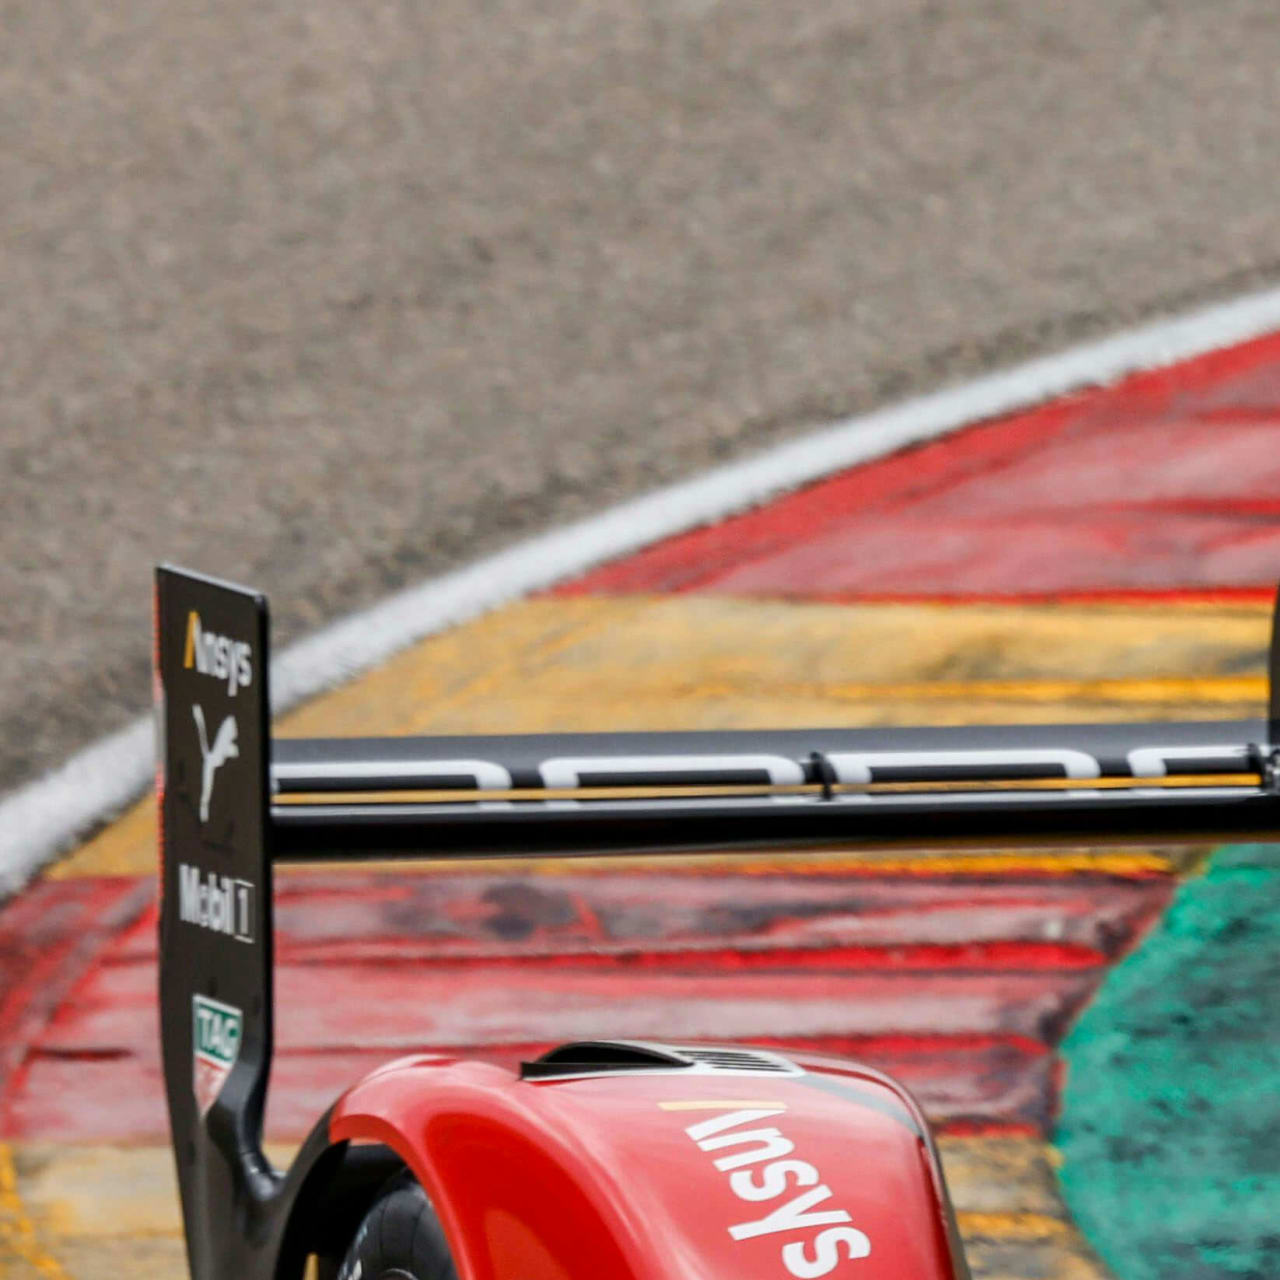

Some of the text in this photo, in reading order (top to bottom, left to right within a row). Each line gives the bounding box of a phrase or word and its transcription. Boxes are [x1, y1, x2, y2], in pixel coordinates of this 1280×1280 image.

[184, 611, 252, 697] Ansys
[179, 864, 234, 935] Mobil
[198, 1007, 241, 1059] TAG
[657, 1100, 871, 1280] Ansys
